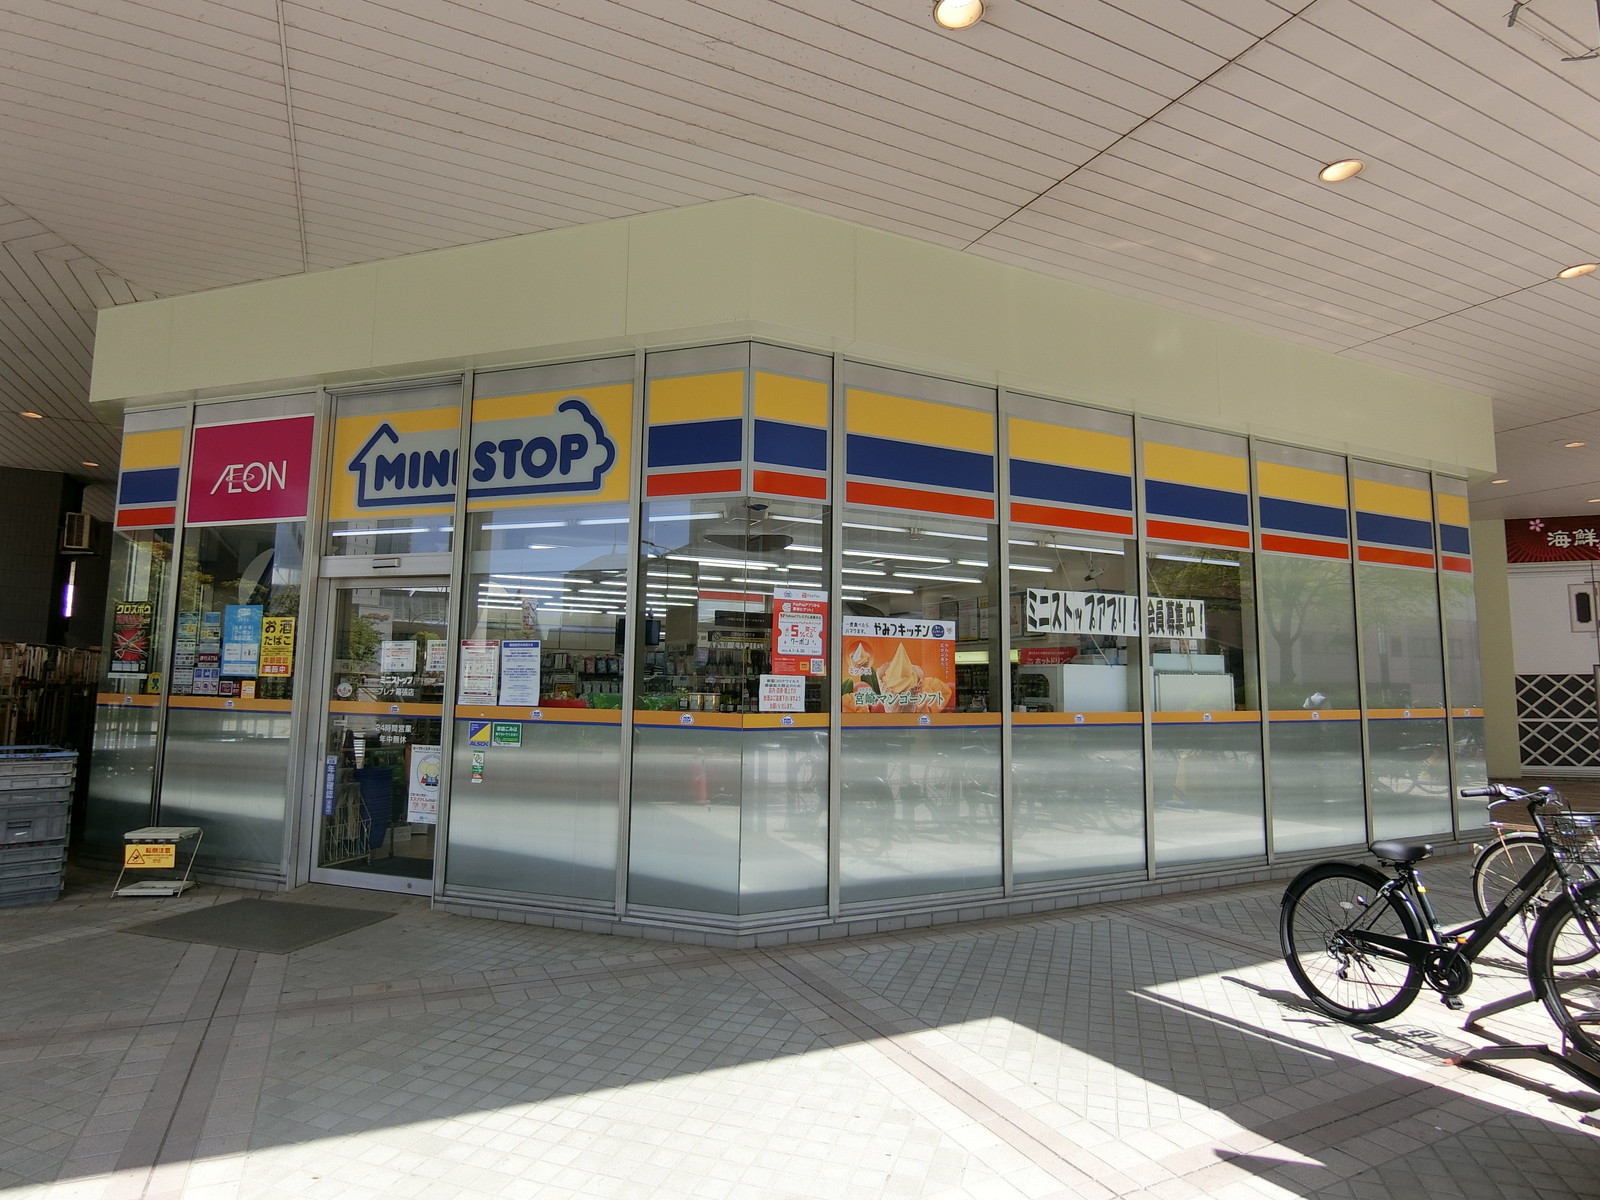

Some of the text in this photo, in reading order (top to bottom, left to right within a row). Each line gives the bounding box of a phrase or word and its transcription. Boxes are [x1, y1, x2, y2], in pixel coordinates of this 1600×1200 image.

[472, 433, 588, 482] STOP
[1546, 528, 1599, 548] 海鮮
[116, 604, 152, 614] クロスボウ
[264, 619, 293, 634] お酒
[263, 635, 292, 646] たばこ
[849, 667, 872, 675] ミックス
[380, 675, 414, 685] ミニストップ
[854, 691, 944, 705] 宮崎マンゴーソフト
[375, 723, 412, 733] 24時間営業
[379, 734, 407, 744] 年中無休
